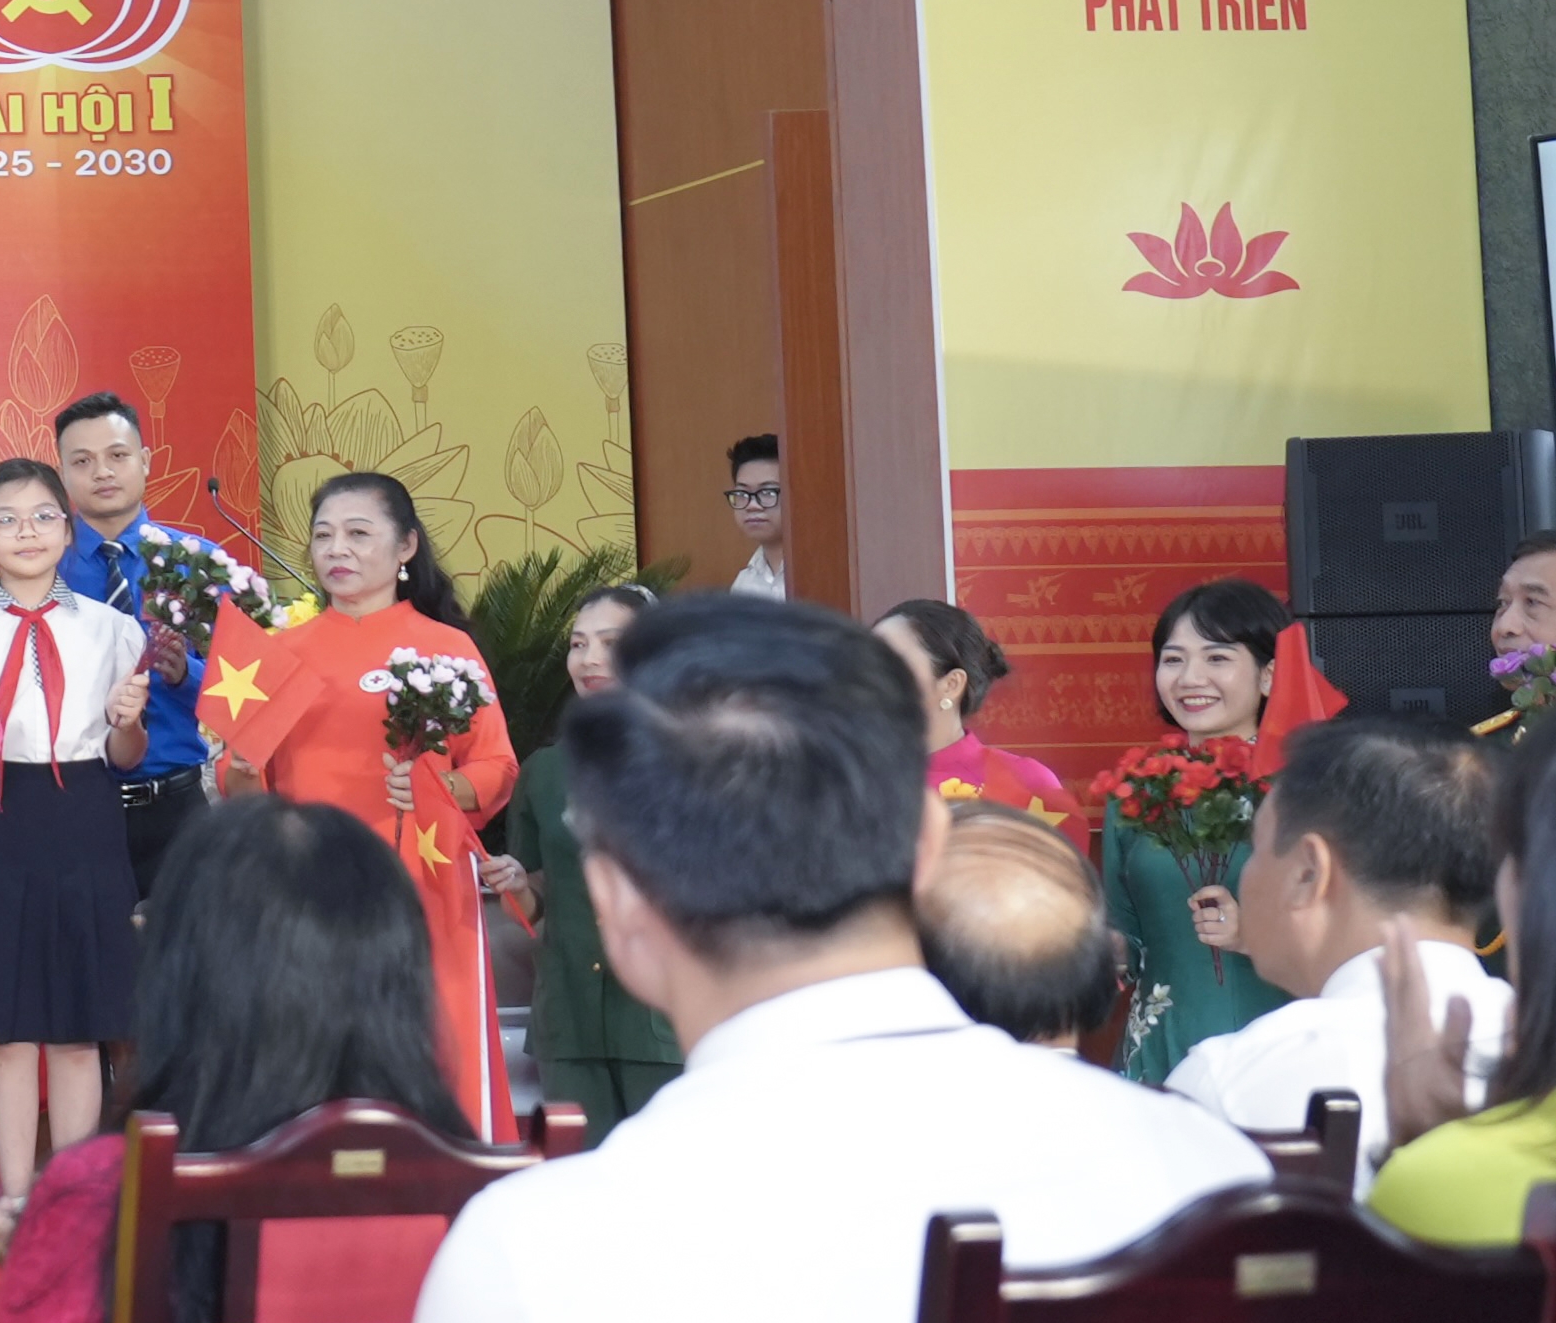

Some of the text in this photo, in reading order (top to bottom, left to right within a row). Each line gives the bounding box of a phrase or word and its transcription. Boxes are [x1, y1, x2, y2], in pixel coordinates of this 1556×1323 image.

[42, 84, 133, 142] HỘI
[146, 74, 174, 132] I
[74, 148, 172, 176] 2030
